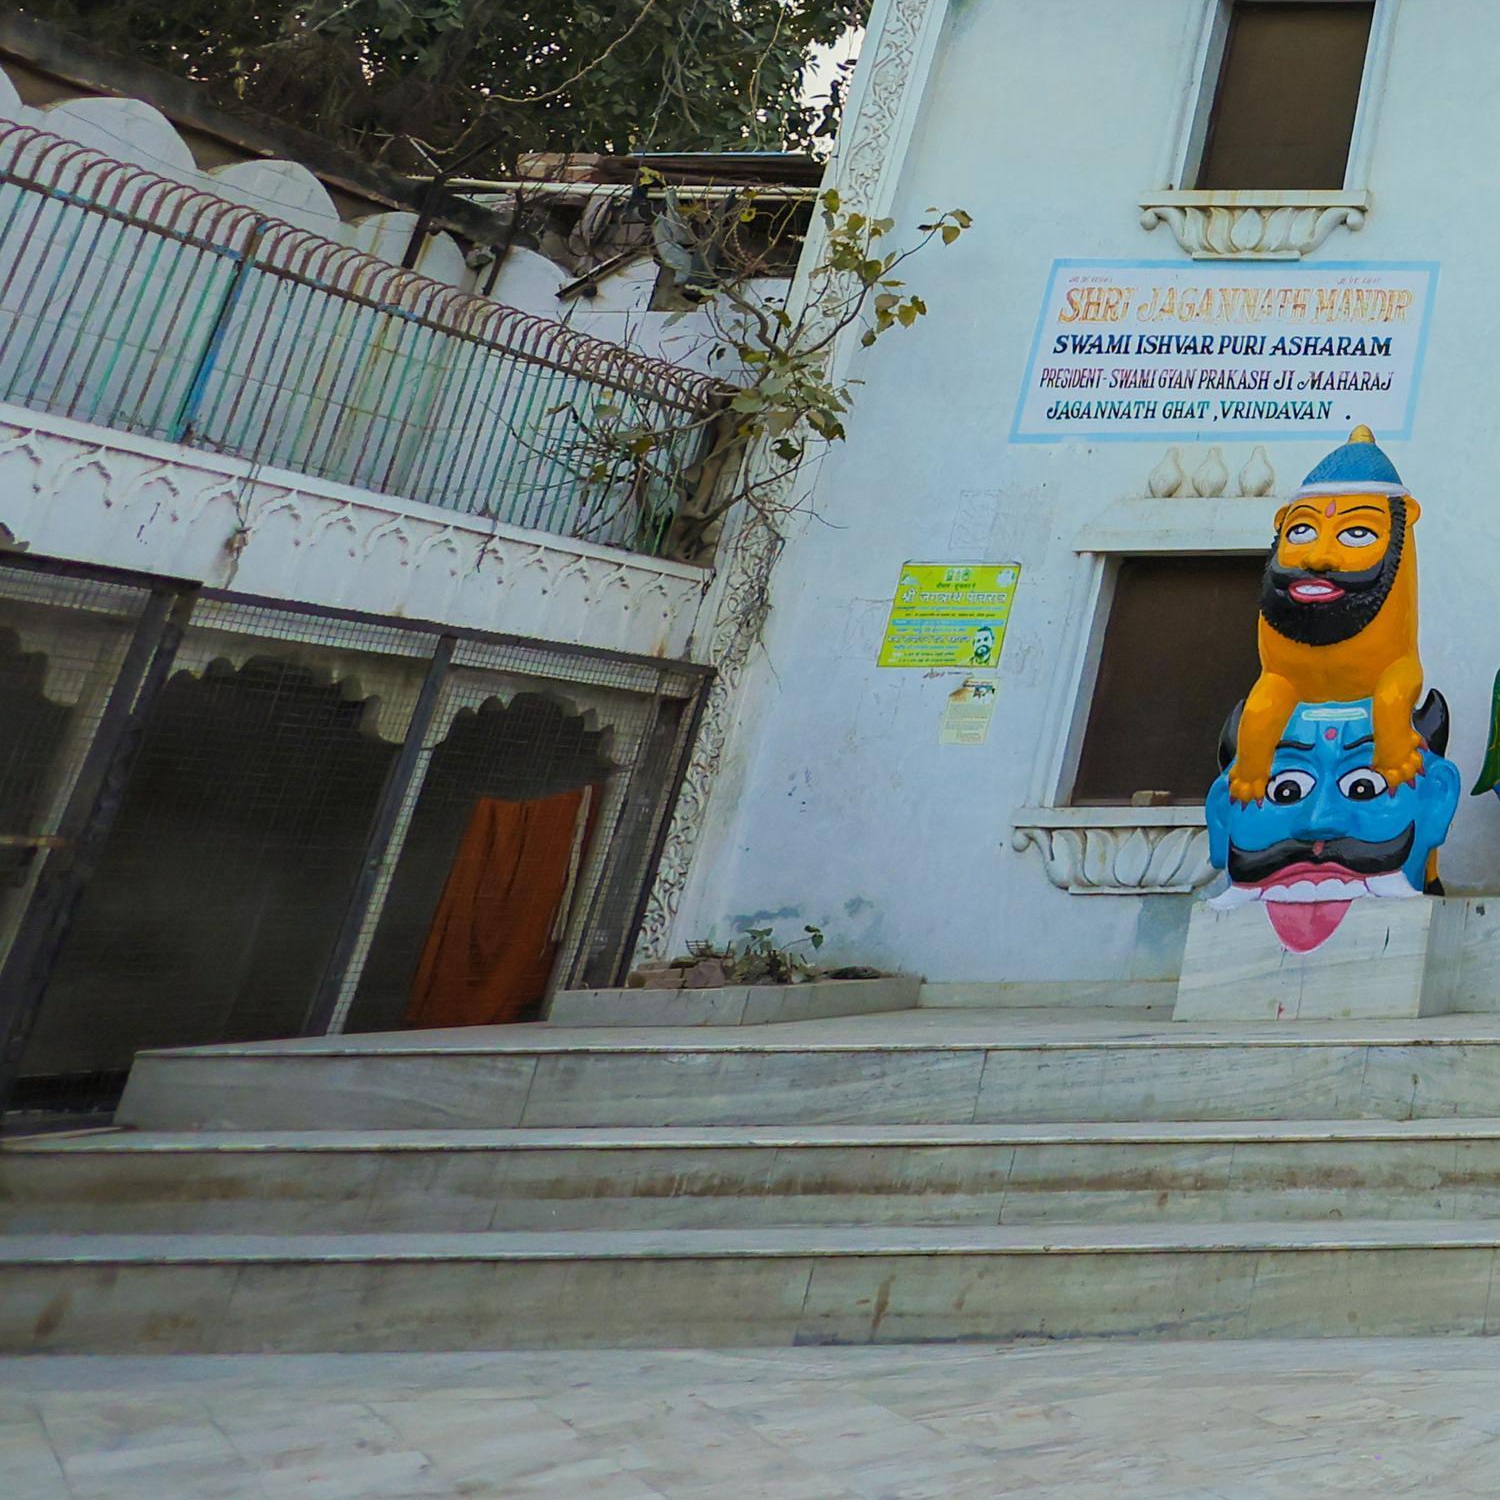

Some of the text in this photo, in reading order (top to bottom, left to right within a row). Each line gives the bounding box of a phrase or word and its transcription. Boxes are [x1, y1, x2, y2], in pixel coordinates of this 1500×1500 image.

[1058, 286, 1414, 325] SHRI JAGANNATH MANDIR
[1053, 334, 1393, 356] SWAMI ISHVAR PURI ASHARAM
[1109, 368, 1158, 389] SWAMI
[1158, 368, 1198, 390] GYAN
[1197, 369, 1272, 390] PRAKASH
[1273, 370, 1295, 390] JI
[1297, 370, 1394, 391] MAHARAJ
[1047, 400, 1158, 420] JAGANNATH
